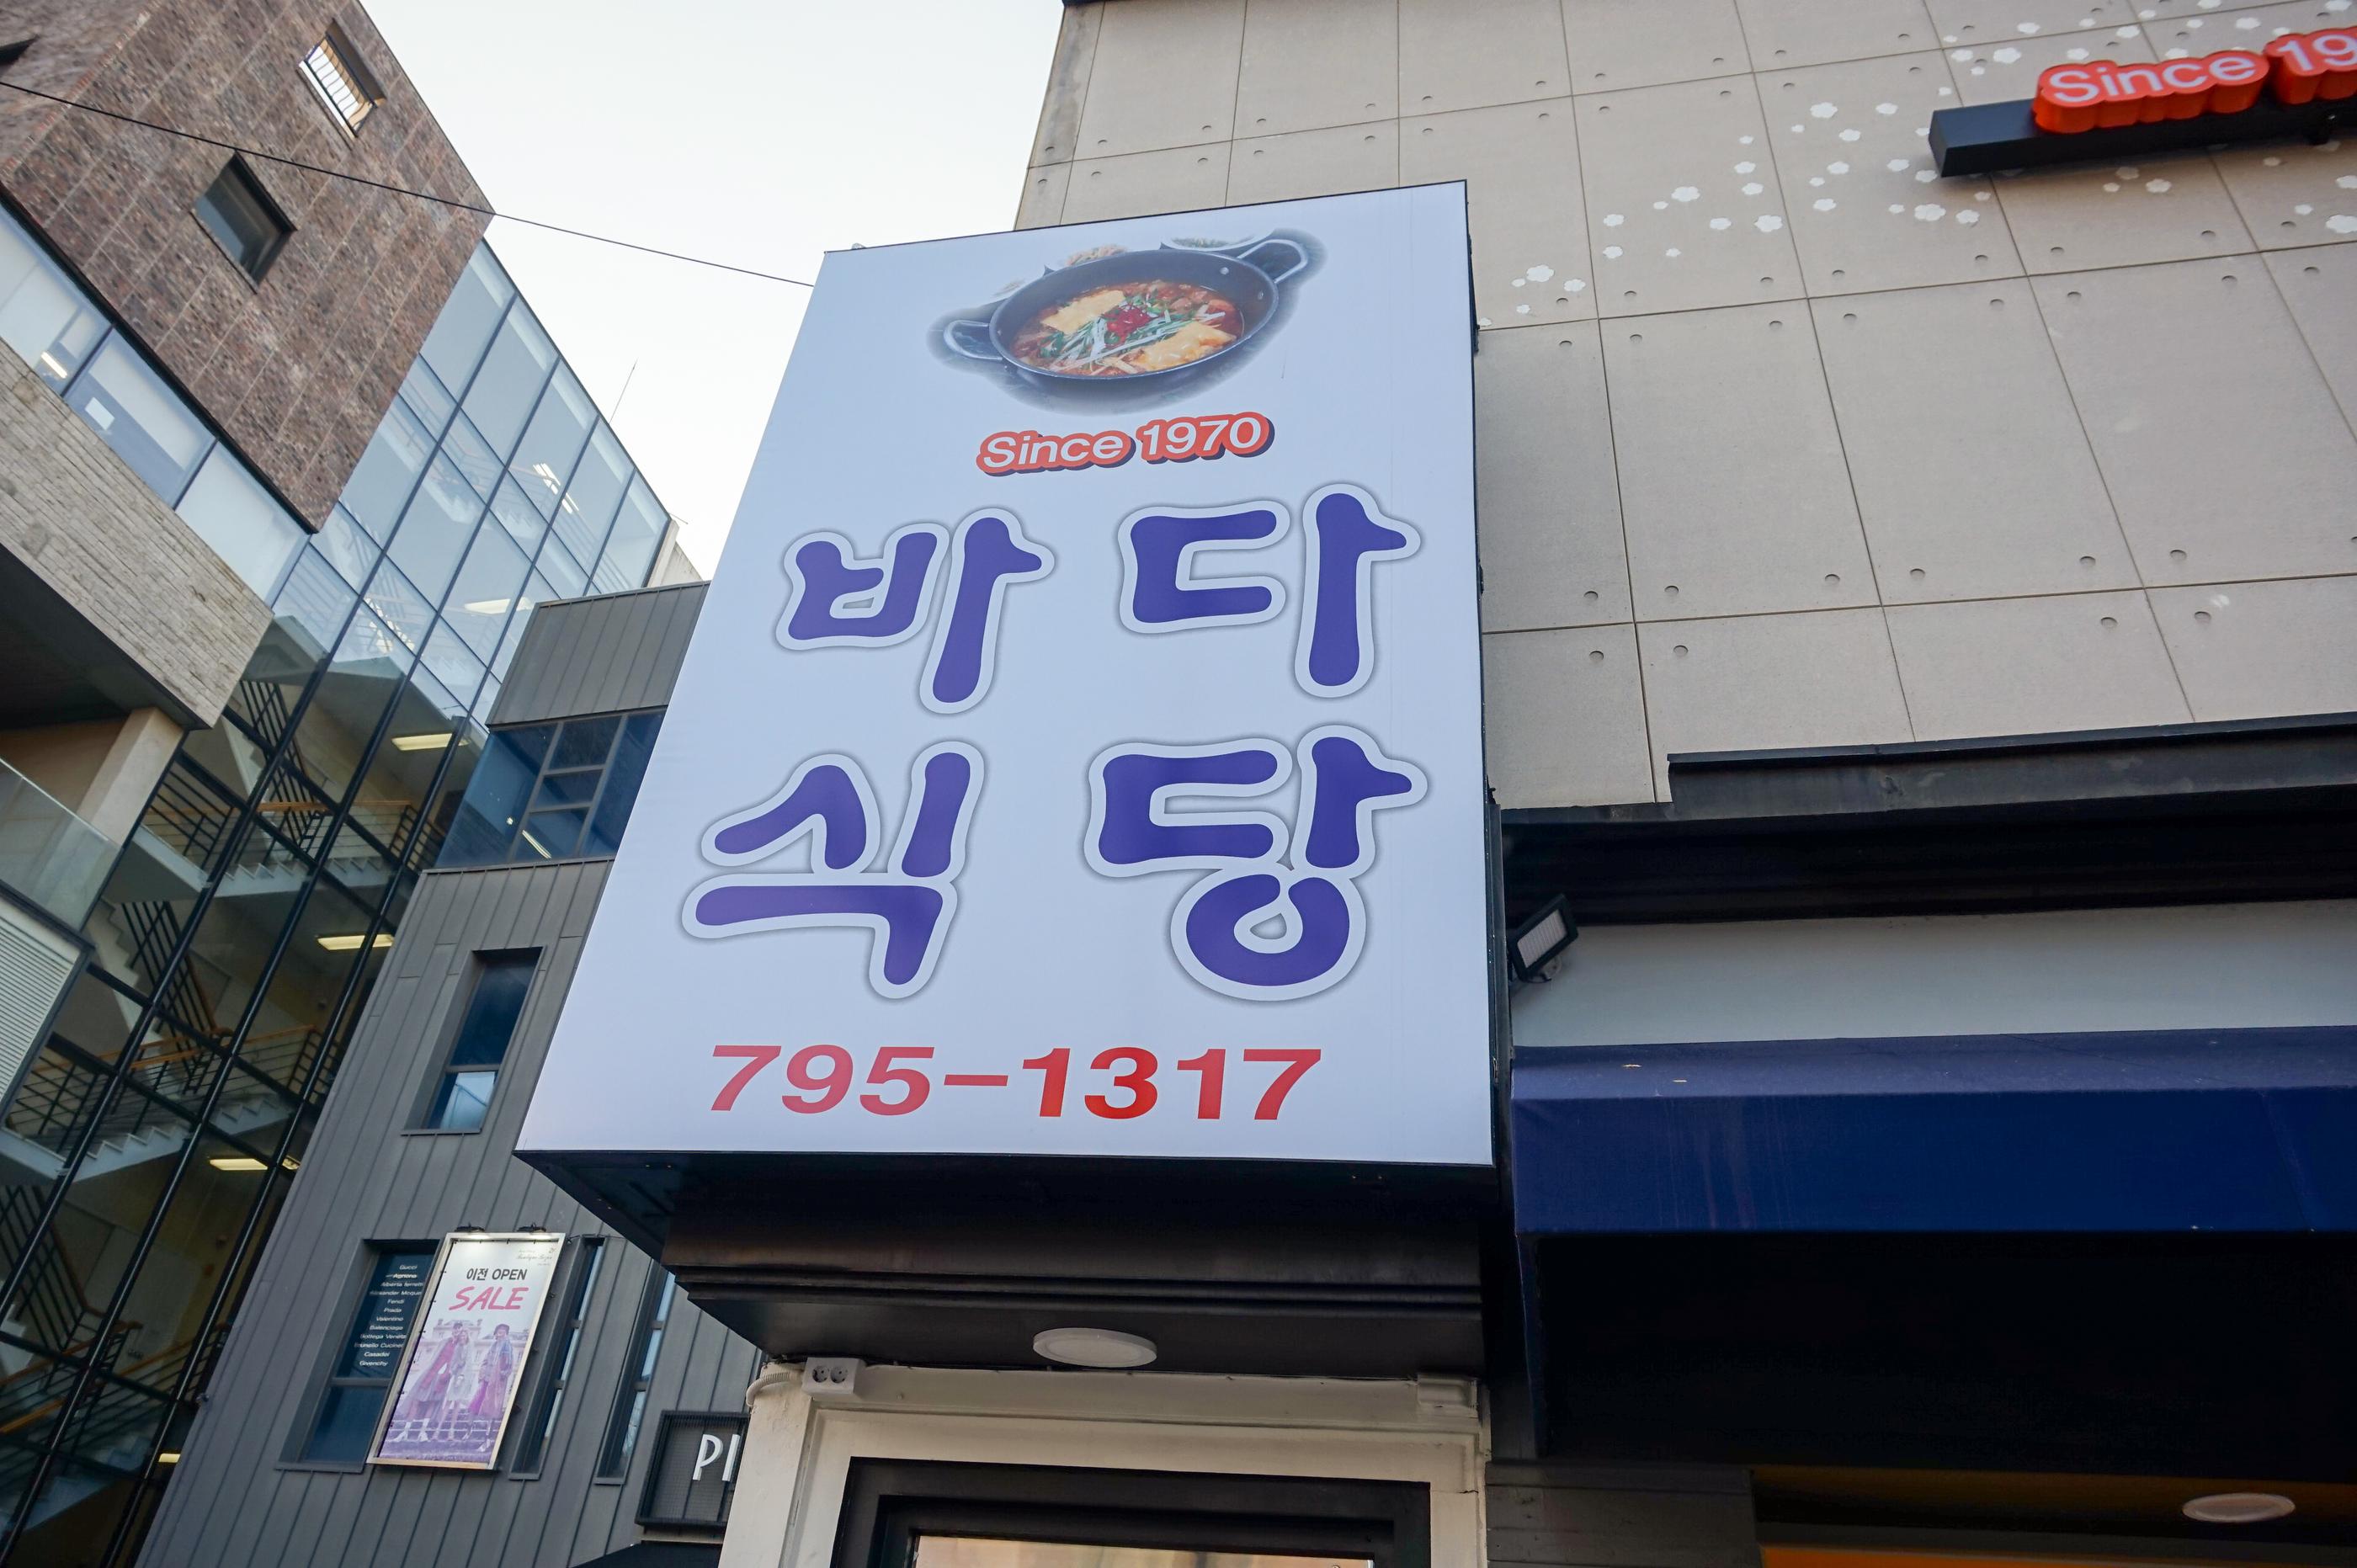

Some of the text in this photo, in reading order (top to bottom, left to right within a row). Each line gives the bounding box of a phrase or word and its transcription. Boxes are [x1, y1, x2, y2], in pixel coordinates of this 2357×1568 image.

[2049, 56, 2256, 103] Since
[983, 417, 1262, 468] Since 1970
[710, 1044, 1321, 1120] 795-1317
[466, 1268, 527, 1280] 이전 OPEN
[449, 1286, 529, 1310] SALE
